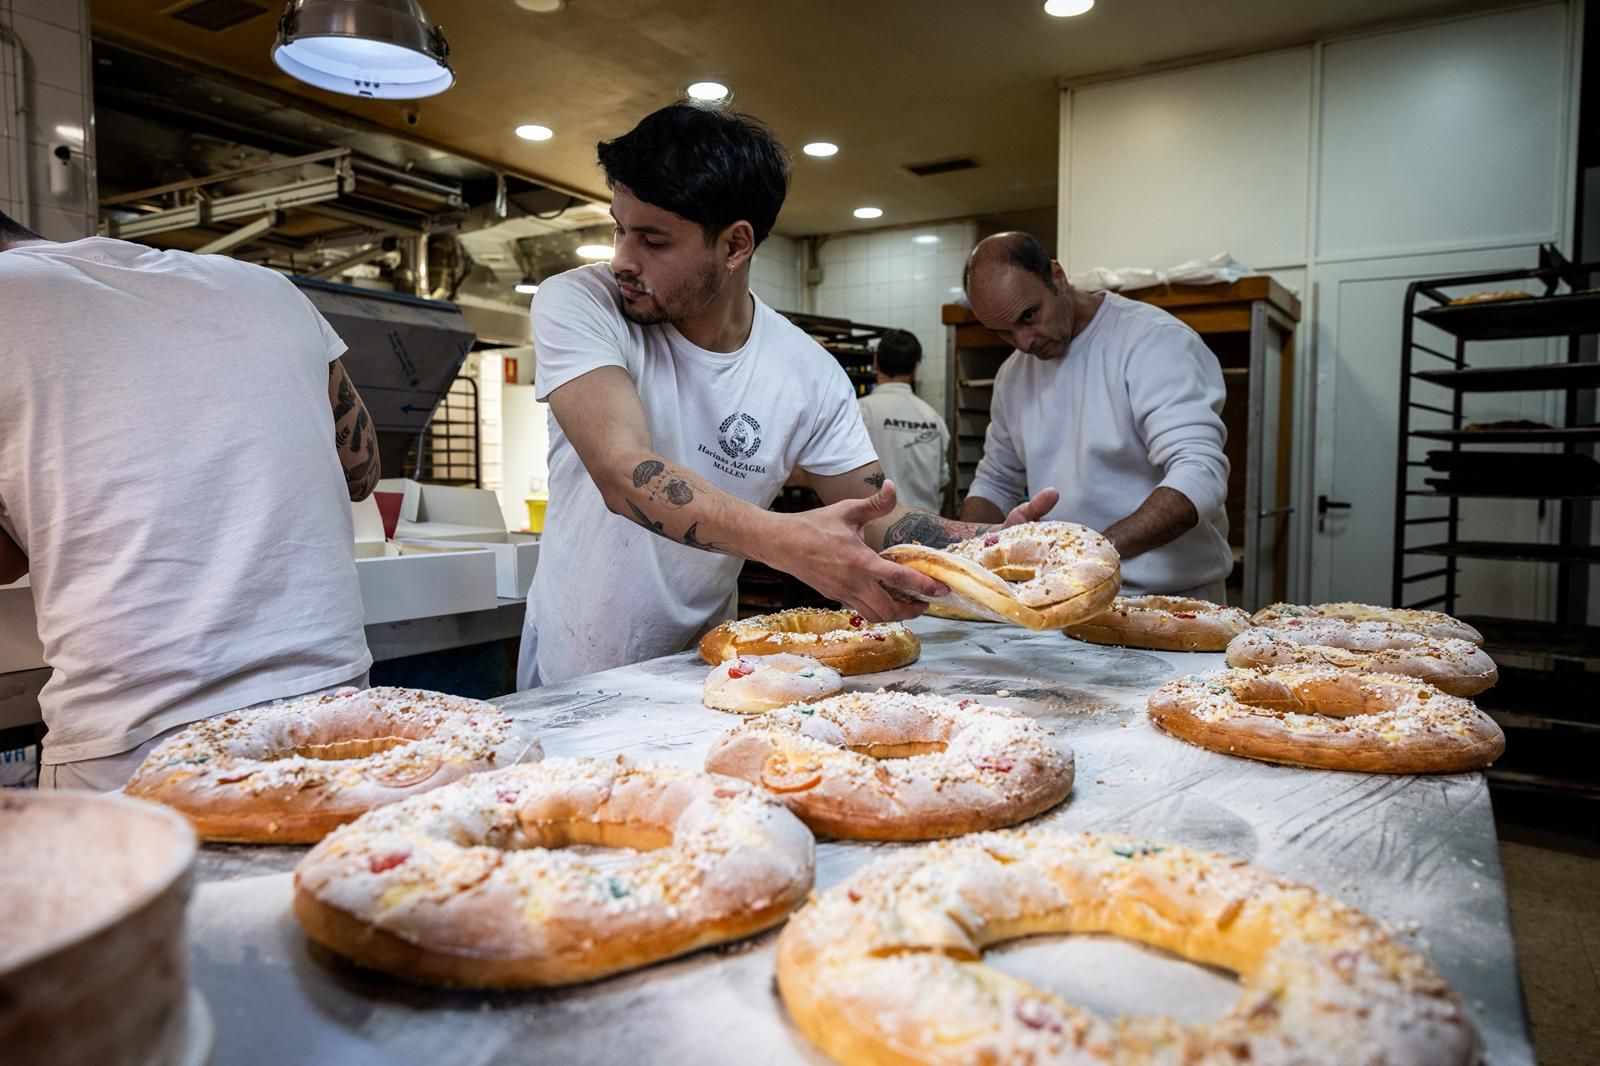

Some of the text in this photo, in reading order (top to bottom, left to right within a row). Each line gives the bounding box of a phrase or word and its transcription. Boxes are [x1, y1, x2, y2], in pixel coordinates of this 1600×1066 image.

[883, 418, 937, 430] ARTEPAN
[697, 444, 766, 474] Harinas AZAGRA
[713, 461, 747, 479] MALLEN
